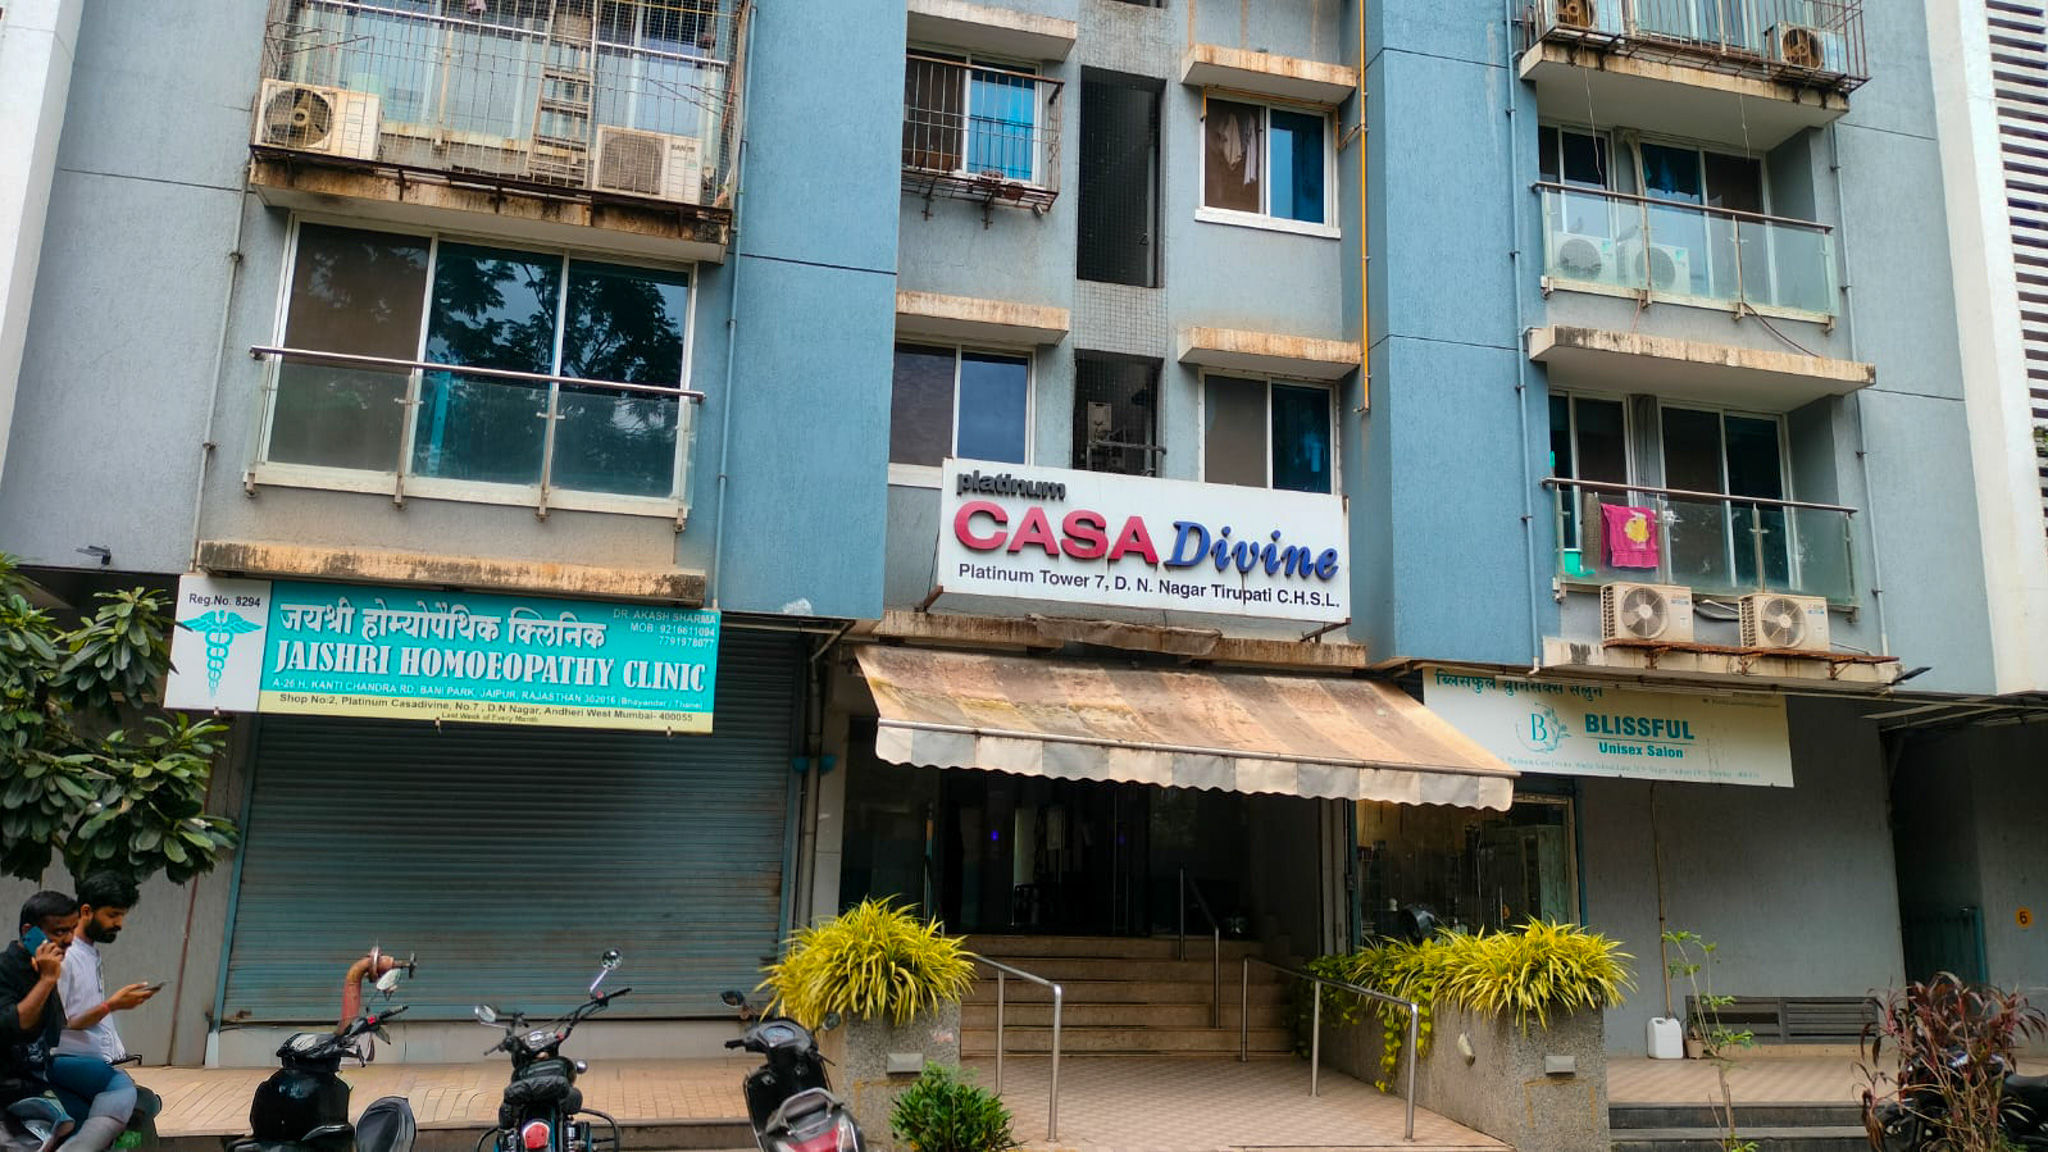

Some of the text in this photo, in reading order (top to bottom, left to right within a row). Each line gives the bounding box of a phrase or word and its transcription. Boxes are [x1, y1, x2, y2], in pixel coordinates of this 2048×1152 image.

[957, 470, 1066, 500] platinum
[954, 501, 1340, 580] CASA Divine
[959, 563, 1340, 608] Platinum Tower 7, D. N. Nagar Tirupati C.H.S.L.
[235, 596, 261, 608] 8294
[280, 597, 356, 634] जयश्री
[508, 606, 607, 649] क्लिनिक
[633, 610, 670, 621] AKASH
[672, 612, 716, 624] SHARMA
[273, 640, 706, 692] JAISHRI HOMOEOPATHY CLINIC
[311, 681, 343, 690] KANTI
[346, 681, 397, 693] CHANDRA
[421, 686, 444, 696] BANI
[522, 690, 582, 704] RAJASTHAN
[280, 694, 307, 704] Shop
[342, 696, 388, 707] Platinum
[544, 706, 584, 718] Andheri
[587, 709, 611, 718] West
[1585, 713, 1695, 740] BLISSFUL
[1598, 742, 1683, 759] Unisex Salon
[2019, 910, 2028, 925] 6
